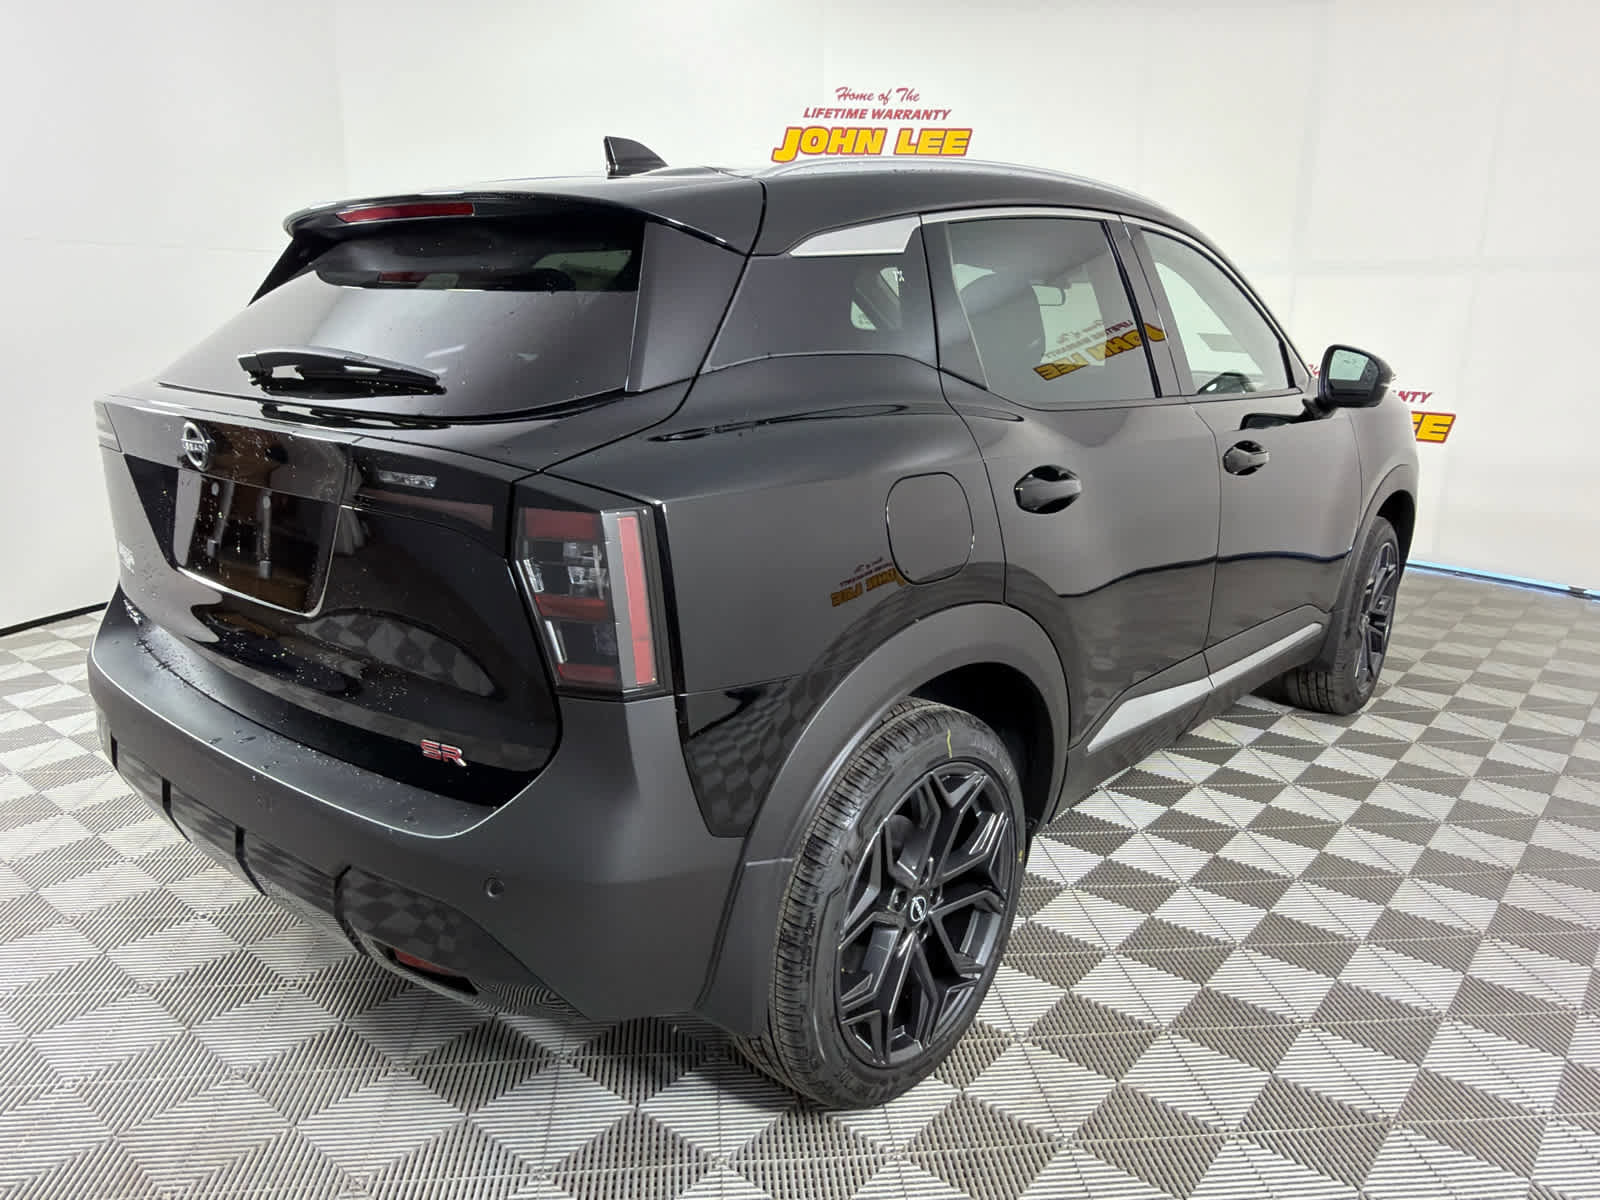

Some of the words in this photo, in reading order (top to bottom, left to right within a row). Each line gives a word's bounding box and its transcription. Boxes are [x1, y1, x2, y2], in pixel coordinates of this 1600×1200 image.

[835, 86, 874, 101] Home
[878, 88, 892, 105] of
[896, 87, 920, 102] The
[803, 107, 868, 119] LIFETIME
[871, 108, 952, 121] WARRANTY
[771, 126, 887, 163] JOHN
[894, 128, 972, 156] LEE
[421, 739, 467, 767] SR
